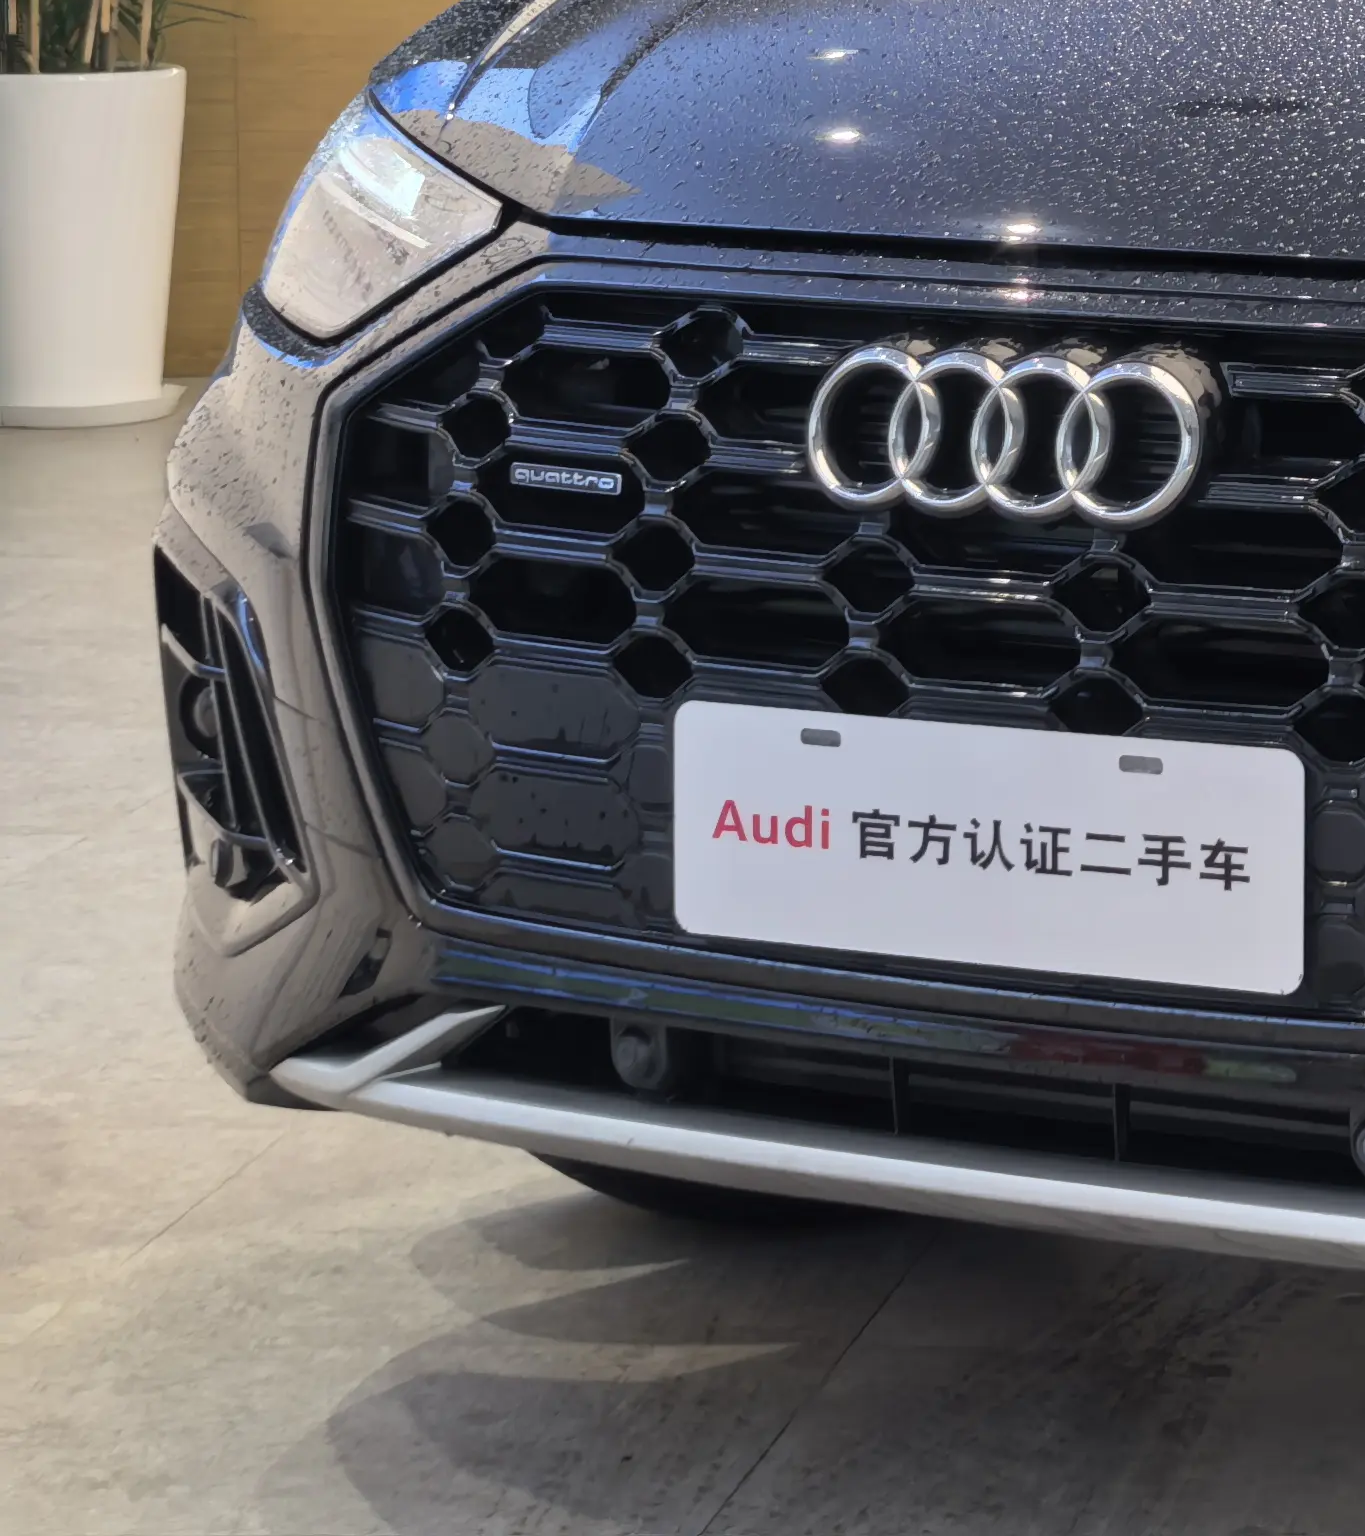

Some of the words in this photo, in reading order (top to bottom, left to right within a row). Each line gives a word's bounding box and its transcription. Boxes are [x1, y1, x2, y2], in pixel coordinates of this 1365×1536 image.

[514, 467, 615, 490] quattro
[712, 799, 831, 850] Audi
[851, 808, 1251, 891] 官方认证二手车
